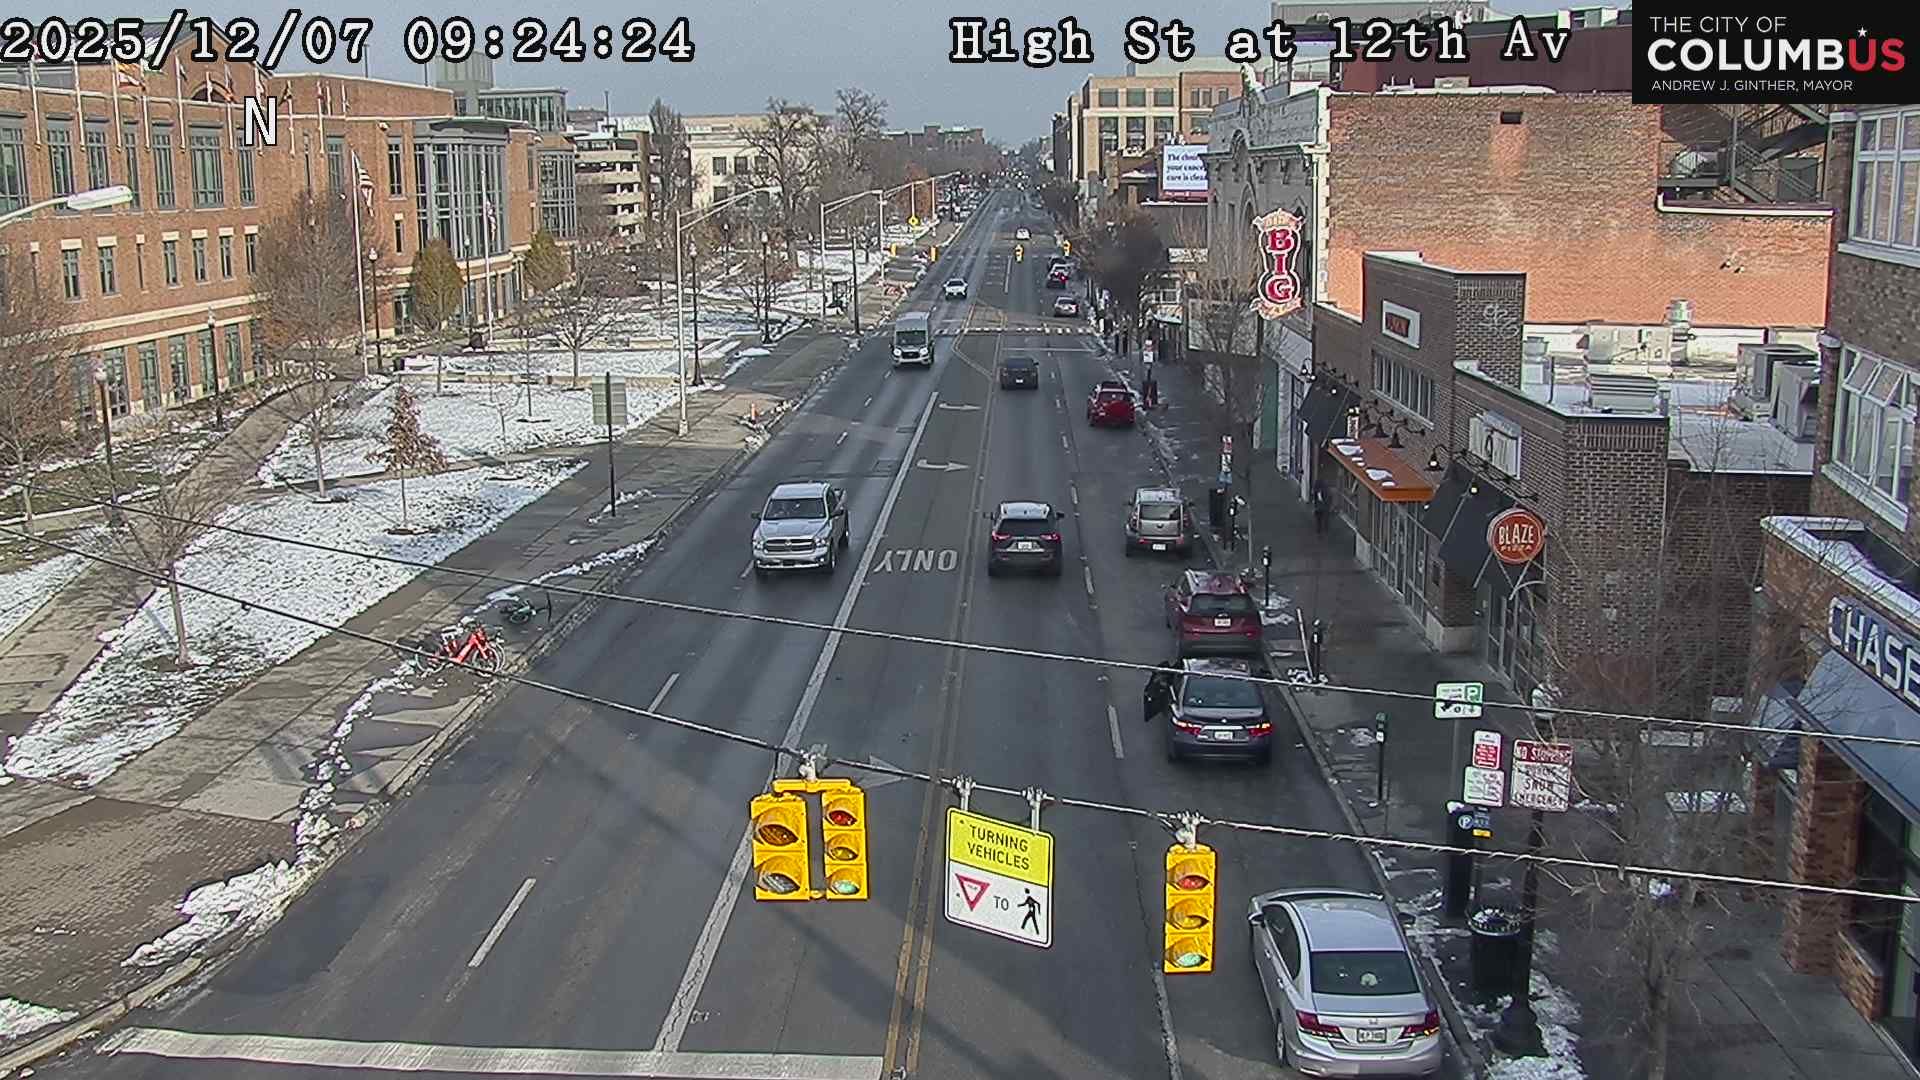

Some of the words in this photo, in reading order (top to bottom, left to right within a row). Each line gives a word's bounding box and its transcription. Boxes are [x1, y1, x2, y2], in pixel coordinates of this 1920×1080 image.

[1265, 227, 1296, 303] BIG
[1498, 523, 1535, 546] BLAZE
[873, 549, 958, 573] ONLY
[1827, 596, 1920, 708] CHASE
[969, 824, 1028, 853] TURNING
[967, 842, 1030, 871] VEHICLES
[993, 895, 1009, 912] TO
